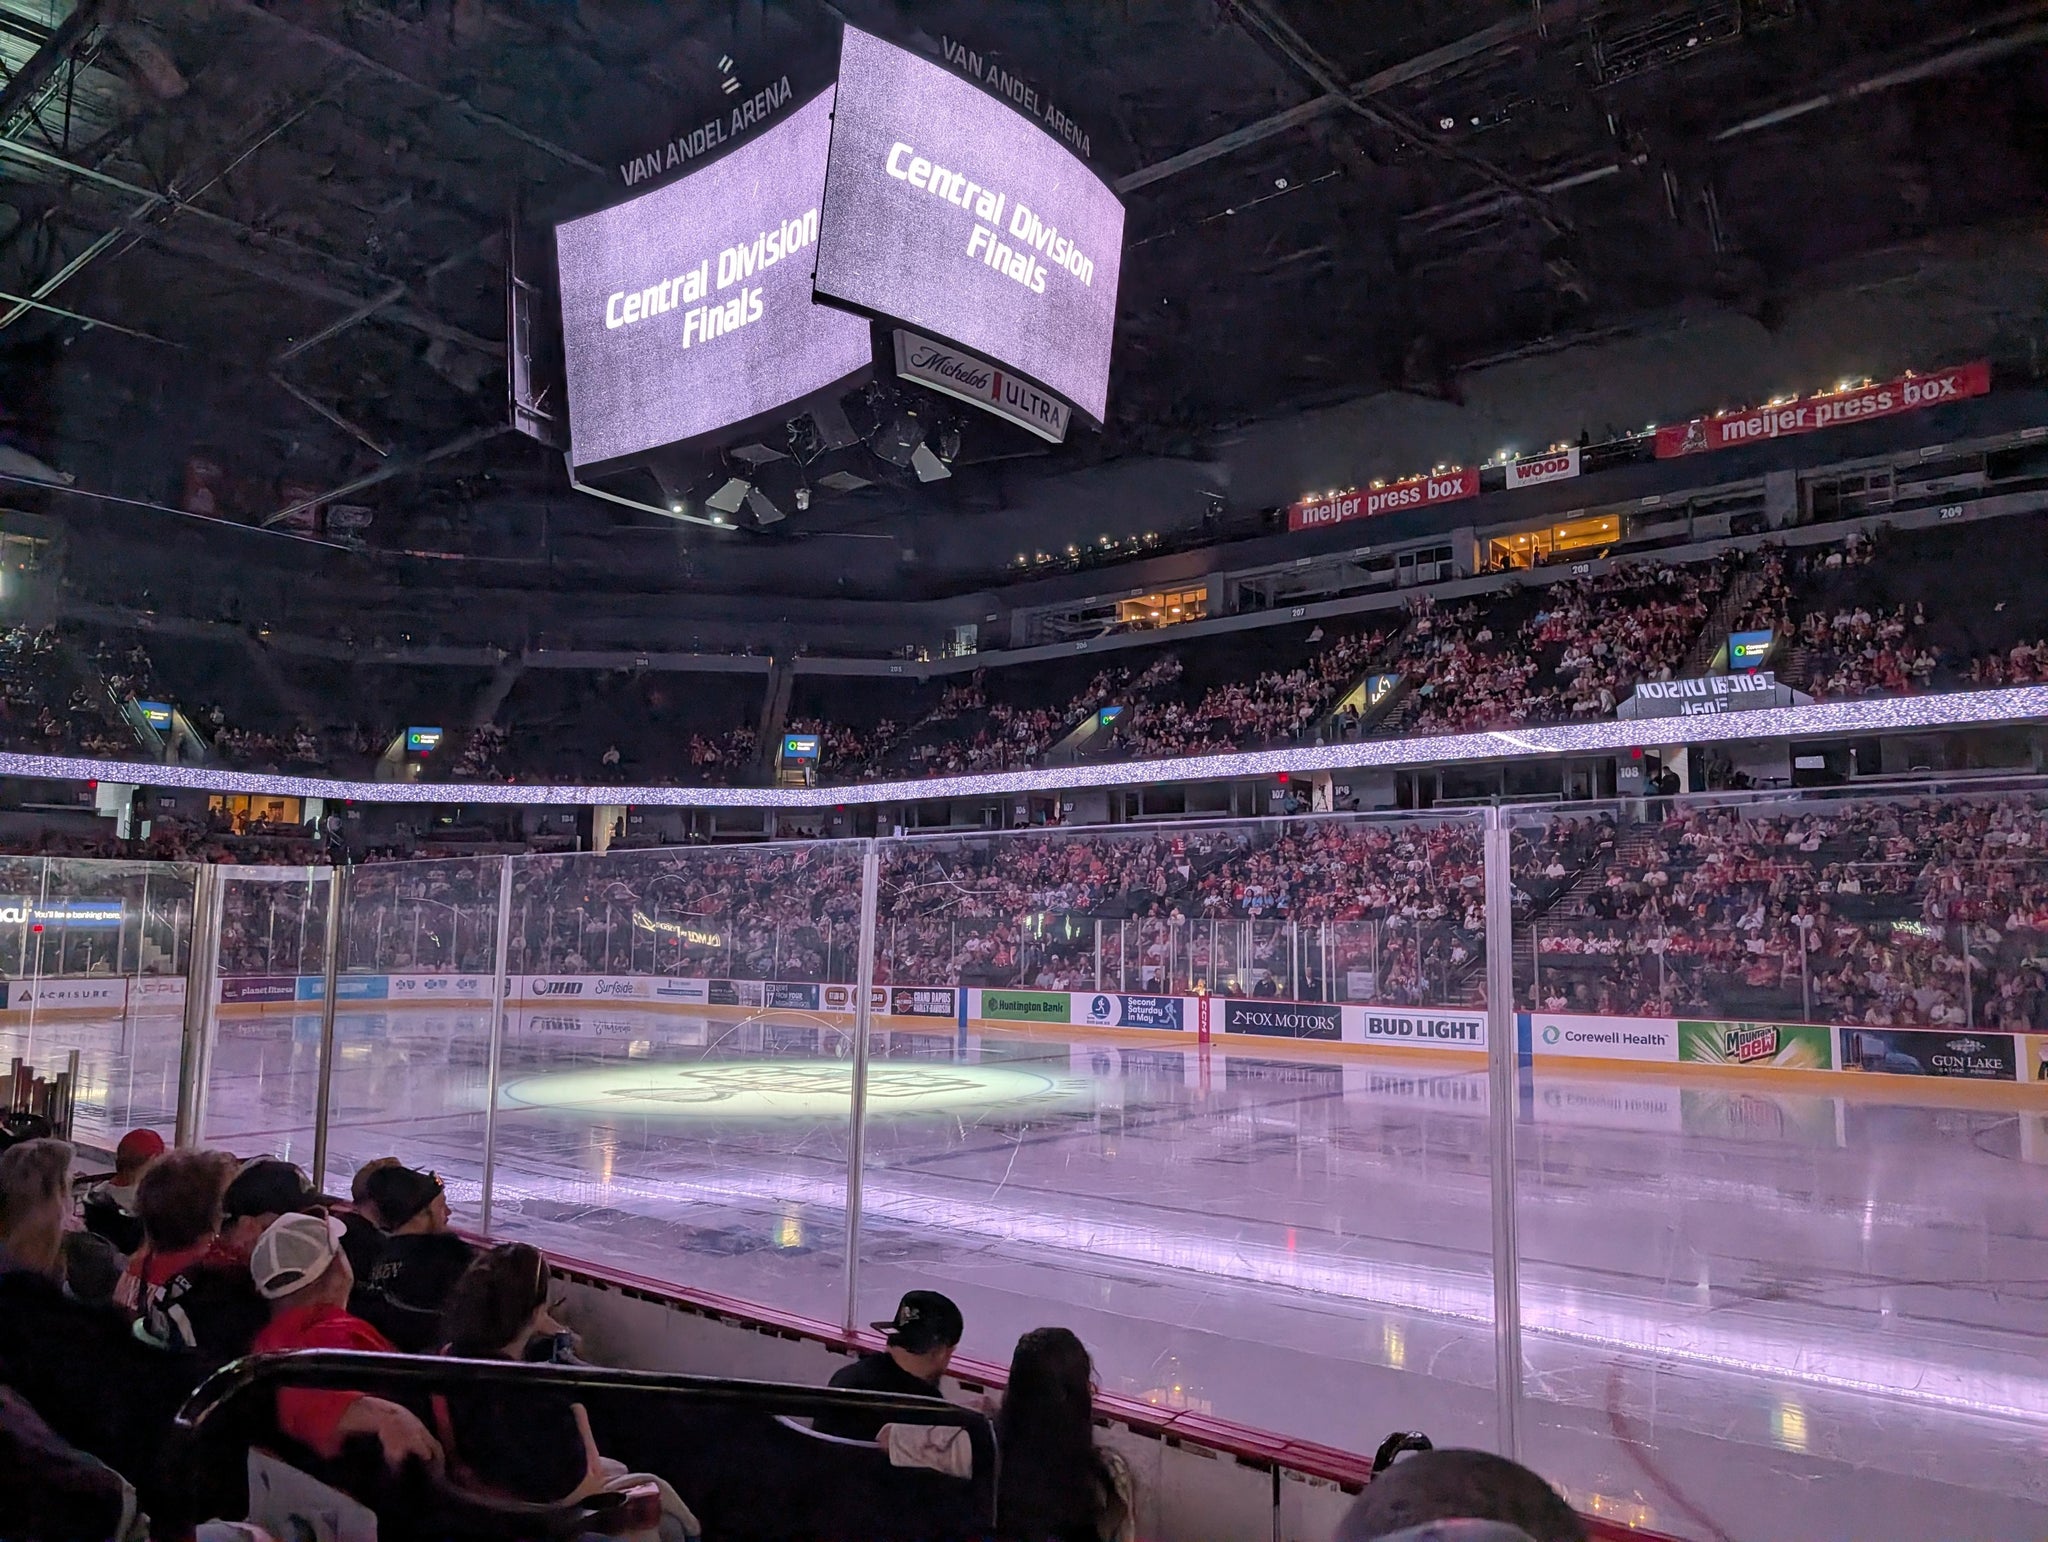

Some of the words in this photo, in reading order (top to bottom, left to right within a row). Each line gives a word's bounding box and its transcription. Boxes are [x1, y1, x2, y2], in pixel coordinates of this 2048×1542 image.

[942, 35, 983, 79] VAN
[986, 65, 1041, 116] ANDEL
[1044, 105, 1090, 157] ARENA
[620, 149, 662, 186] VAN
[666, 118, 728, 170] ANDEL
[731, 75, 793, 136] ARENA
[886, 141, 1006, 226] Central
[1009, 202, 1094, 287] Division
[966, 223, 1048, 294] Finals
[605, 258, 709, 330] Central
[716, 208, 818, 290] Division
[682, 286, 764, 349] Finals
[910, 346, 991, 389] Michelob
[1006, 381, 1062, 428] ULTRA
[1722, 407, 1804, 441] meijer
[1815, 390, 1892, 427] press
[1903, 376, 1957, 404] box
[1516, 458, 1569, 479] WOOD
[1302, 498, 1360, 524] meijer
[1367, 485, 1420, 515] press
[1427, 477, 1463, 499] box
[1940, 506, 1962, 519] 209
[1572, 564, 1589, 575] 208
[1292, 608, 1305, 617] 207
[1620, 767, 1639, 778] 108
[1272, 790, 1285, 799] 107
[1335, 786, 1350, 795] 108
[34, 910, 54, 918] You'll
[73, 911, 102, 920] banking
[103, 911, 121, 919] here.
[595, 979, 633, 995] Surfside
[39, 990, 109, 999] ACRISURE
[767, 992, 774, 1005] 17
[914, 992, 930, 1002] GRAND
[931, 992, 951, 1002] RAPIDS
[1128, 997, 1156, 1006] Second
[999, 1000, 1041, 1013] Huntington
[1042, 1002, 1063, 1013] Bank
[1128, 1005, 1163, 1016] Saturday
[1137, 1014, 1153, 1024] May
[1245, 1012, 1273, 1026] FOX
[1275, 1014, 1335, 1030] MOTORS
[1369, 1018, 1412, 1036] BUD
[1416, 1020, 1479, 1040] LIGHT
[1565, 1031, 1620, 1043] Corewell
[1623, 1034, 1666, 1046] Health
[1932, 1055, 1964, 1067] GUN
[1967, 1057, 2003, 1069] LAKE
